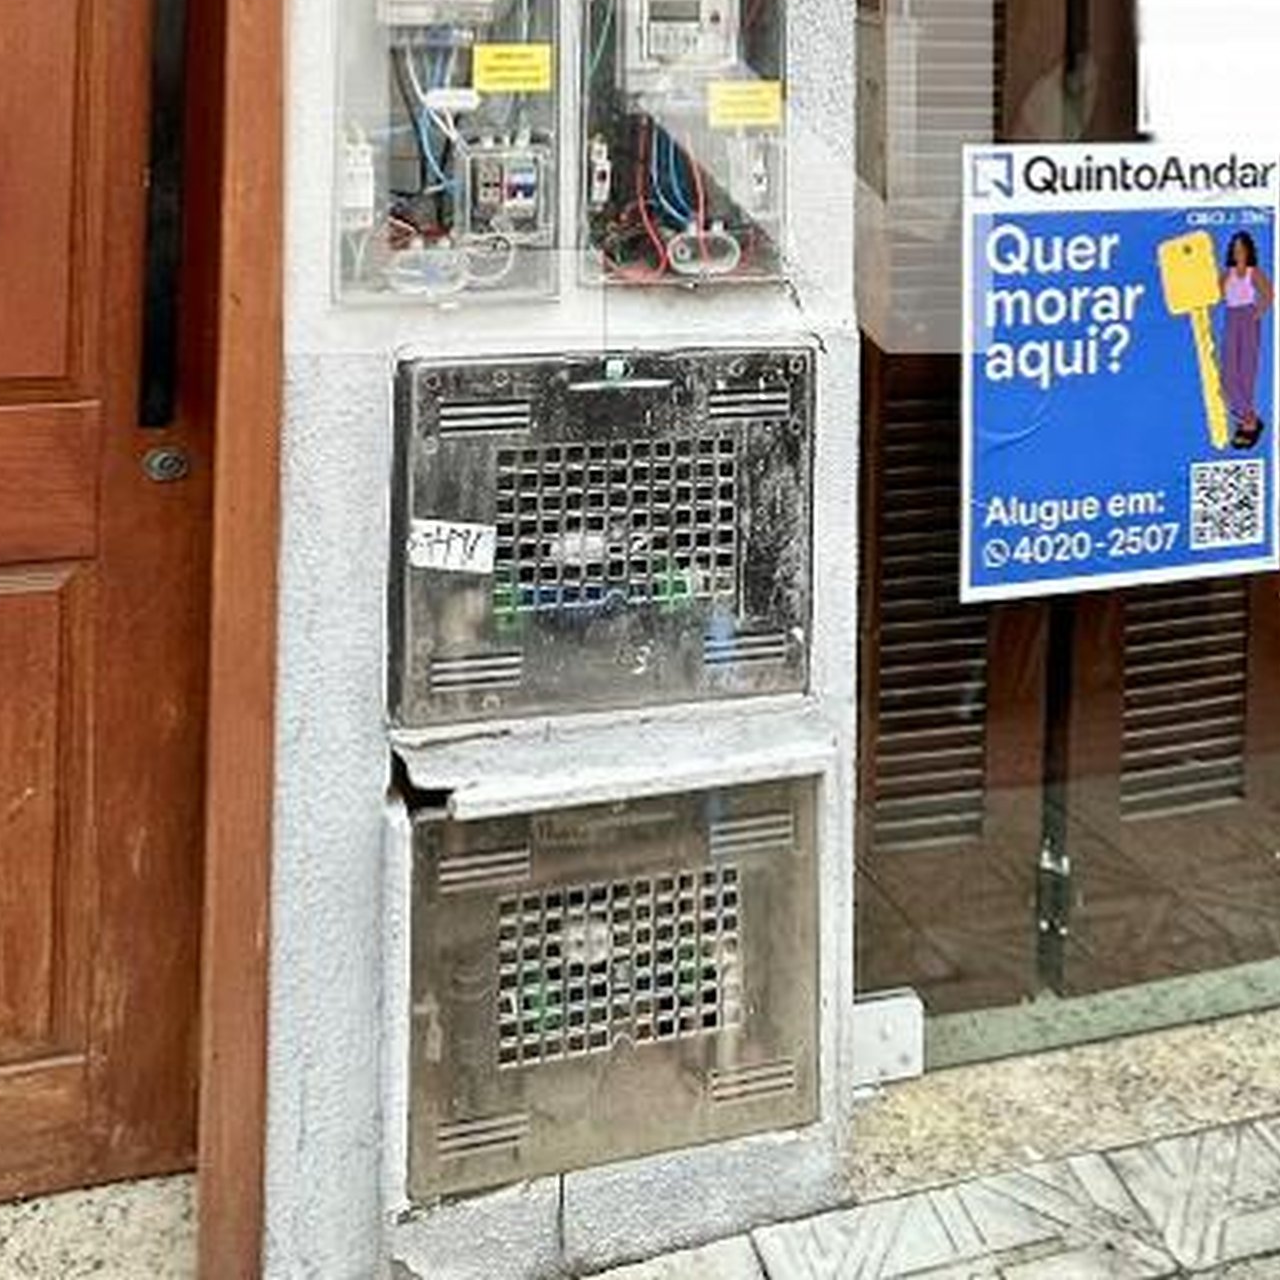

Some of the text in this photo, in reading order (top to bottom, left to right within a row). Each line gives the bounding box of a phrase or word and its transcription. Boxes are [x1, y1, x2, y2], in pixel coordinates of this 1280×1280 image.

[1023, 154, 1276, 195] QuintoAndar
[986, 223, 1119, 274] Quer
[986, 284, 1145, 327] morar
[985, 323, 1131, 390] aqui?
[984, 490, 1166, 532] Alugue em:
[1013, 522, 1181, 564] 4020-2507
